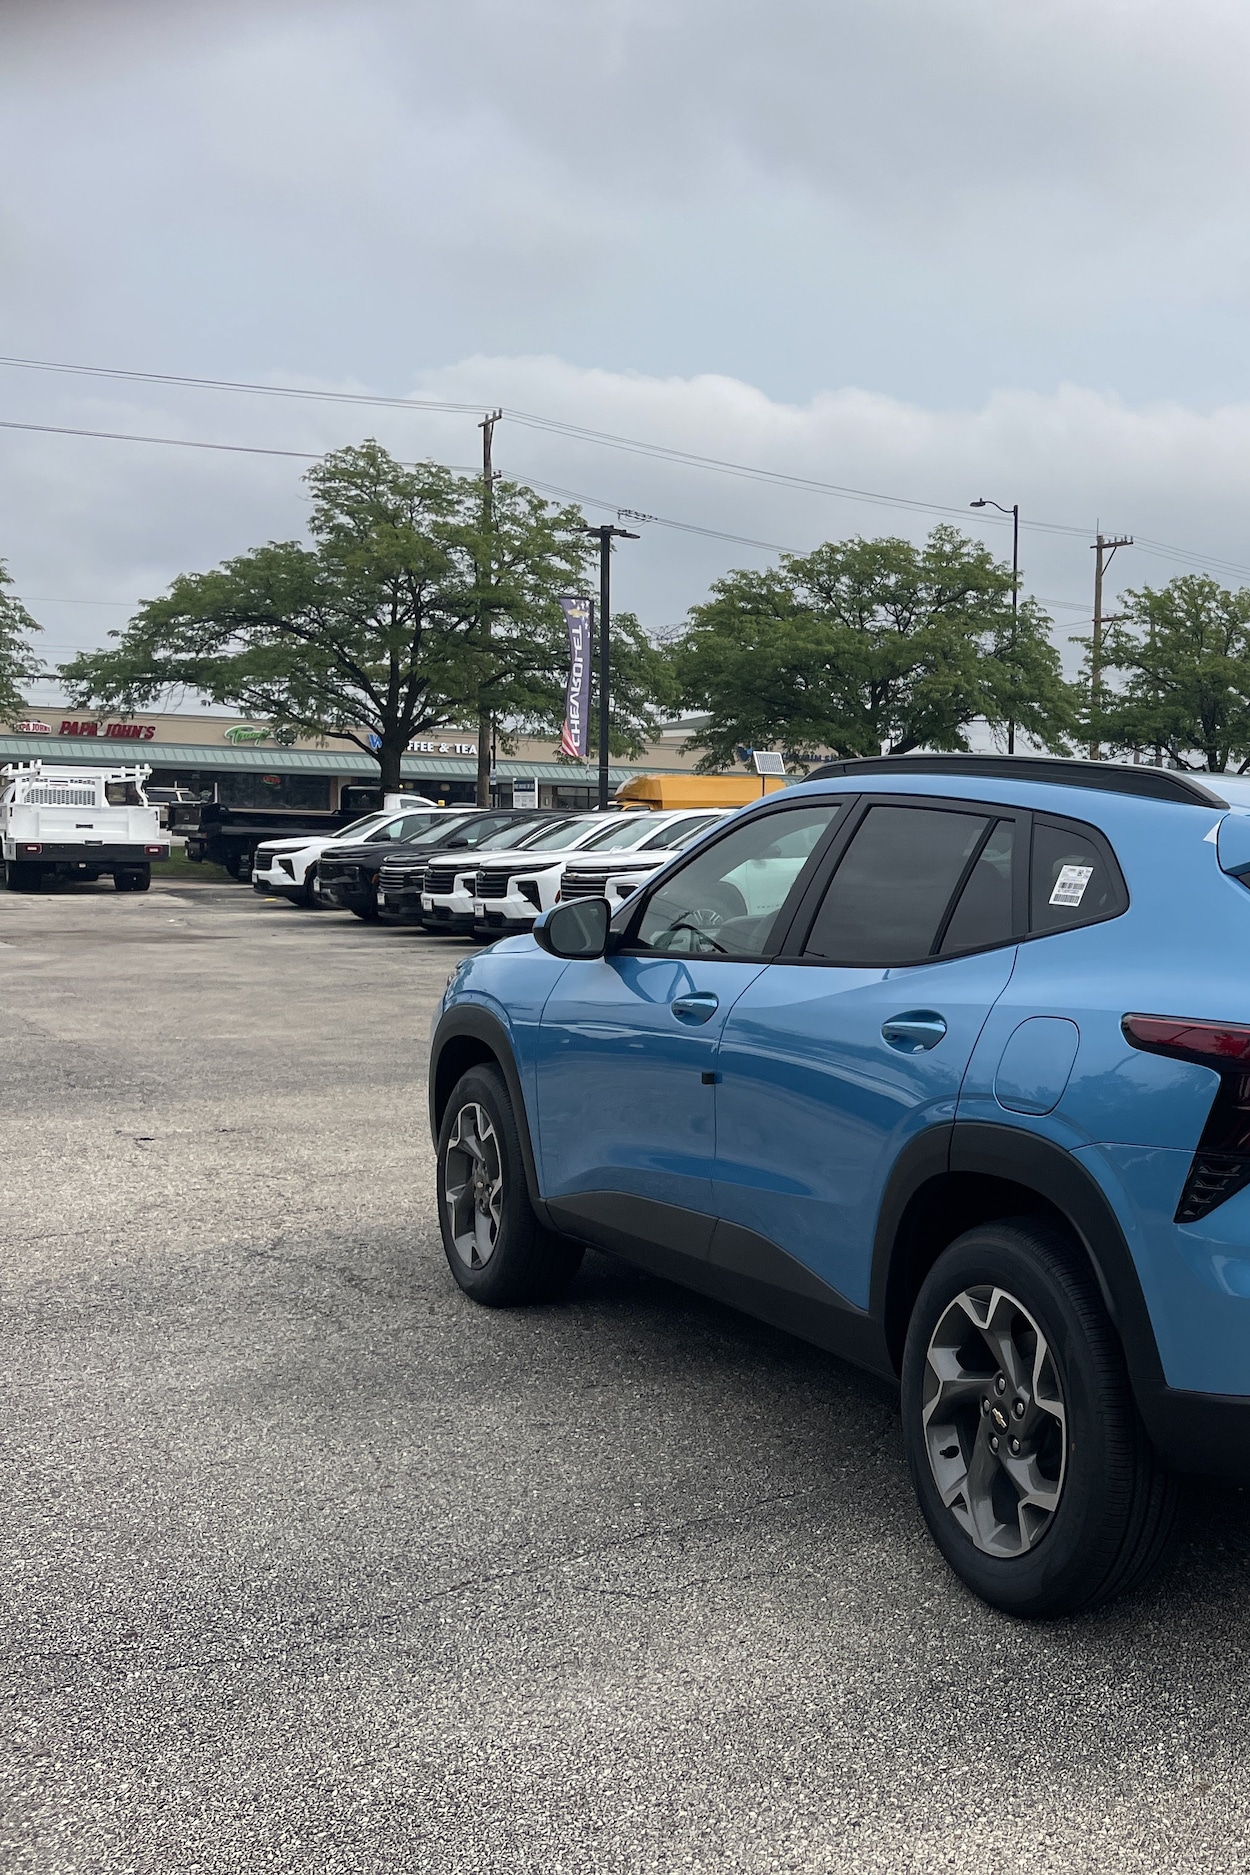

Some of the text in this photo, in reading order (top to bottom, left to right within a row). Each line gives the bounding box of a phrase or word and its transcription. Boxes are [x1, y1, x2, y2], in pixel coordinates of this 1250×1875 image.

[58, 721, 156, 740] PAPA JOHN'S
[407, 740, 477, 755] FFEE & TEA
